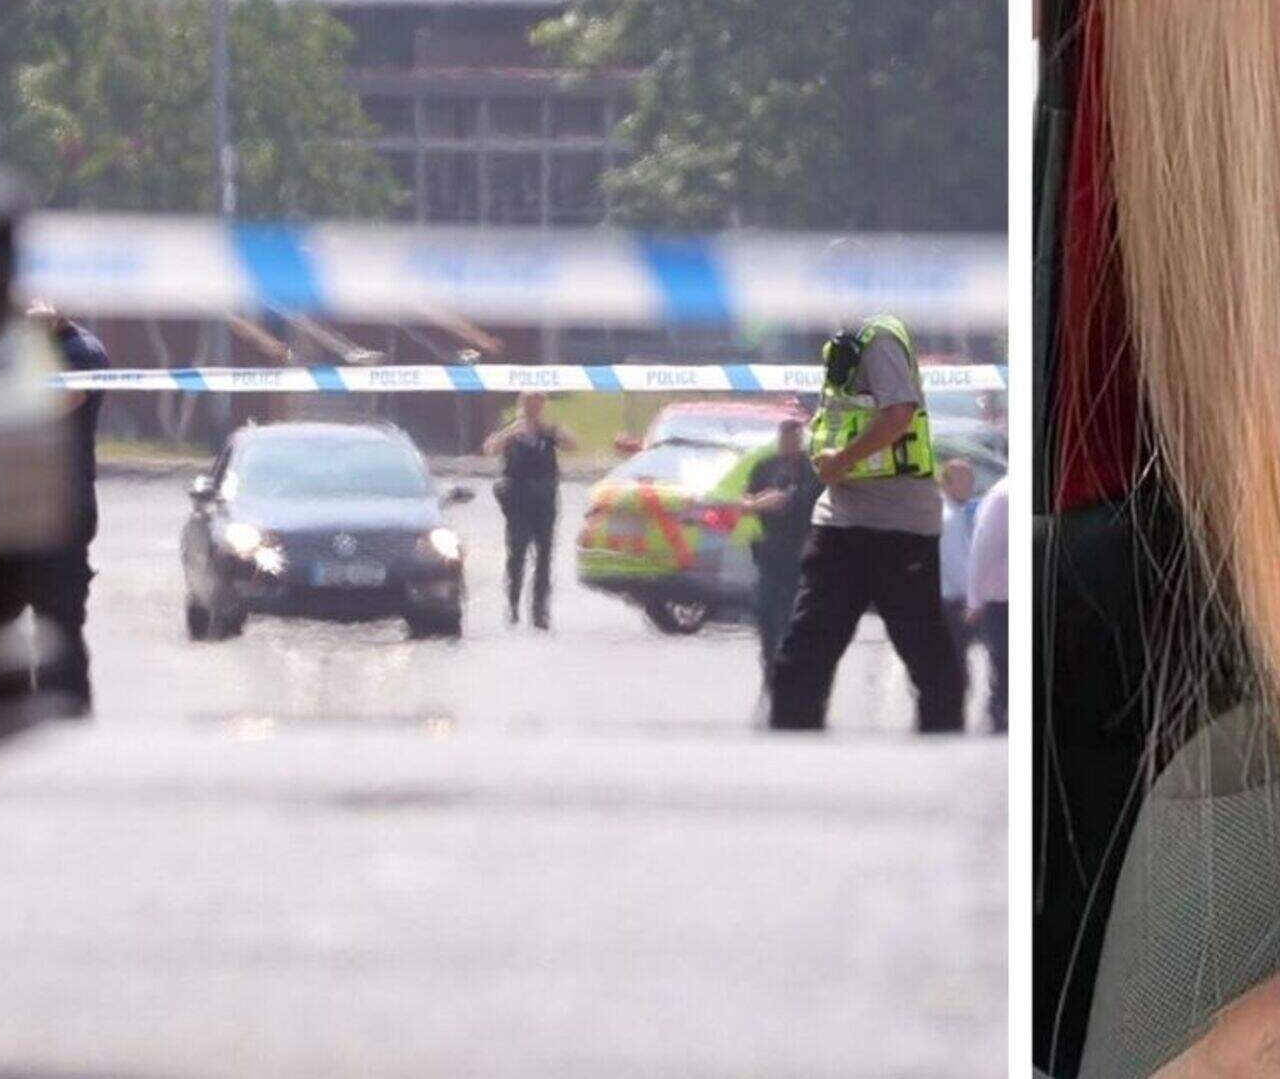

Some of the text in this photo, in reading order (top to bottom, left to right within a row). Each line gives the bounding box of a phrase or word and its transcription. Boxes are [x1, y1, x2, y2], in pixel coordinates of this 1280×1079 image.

[231, 370, 282, 386] POLICE
[370, 370, 421, 386] POLICE
[508, 370, 560, 386] POLICE
[646, 370, 698, 386] POLICE
